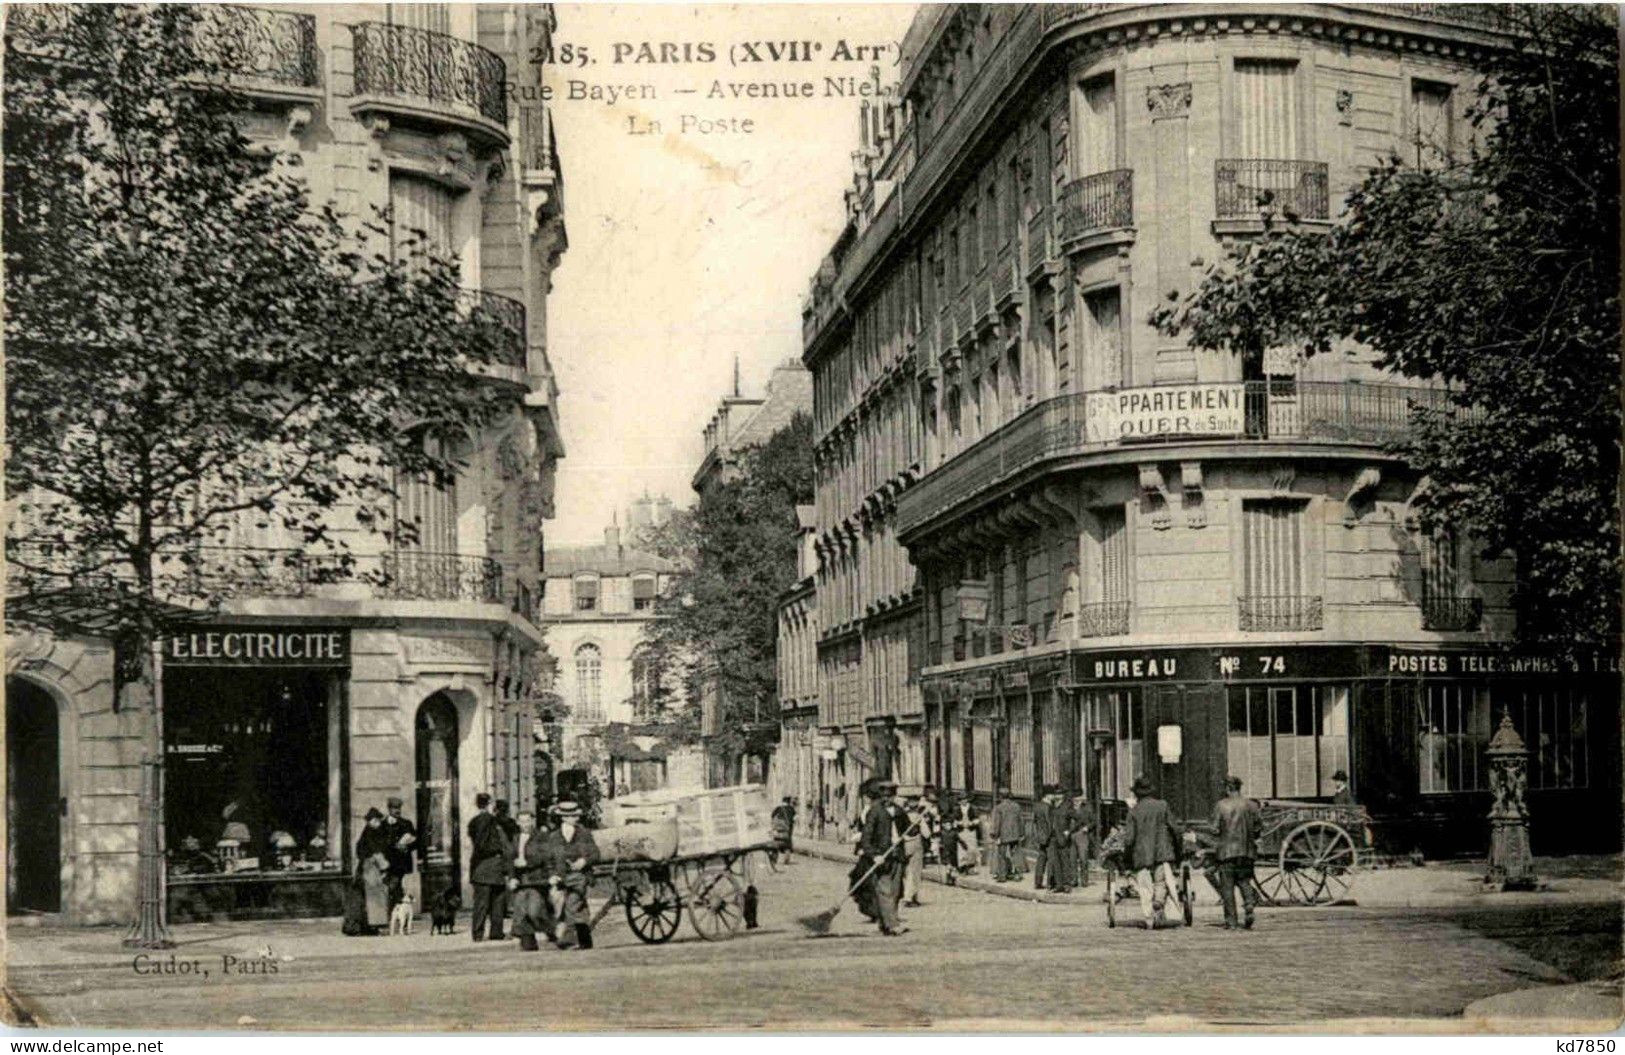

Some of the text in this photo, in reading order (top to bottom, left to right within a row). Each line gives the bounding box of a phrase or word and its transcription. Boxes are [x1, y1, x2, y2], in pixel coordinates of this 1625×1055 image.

[1094, 658, 1177, 678] BUREAU
[1259, 656, 1286, 674] 74
[1389, 655, 1448, 672] POSTES
